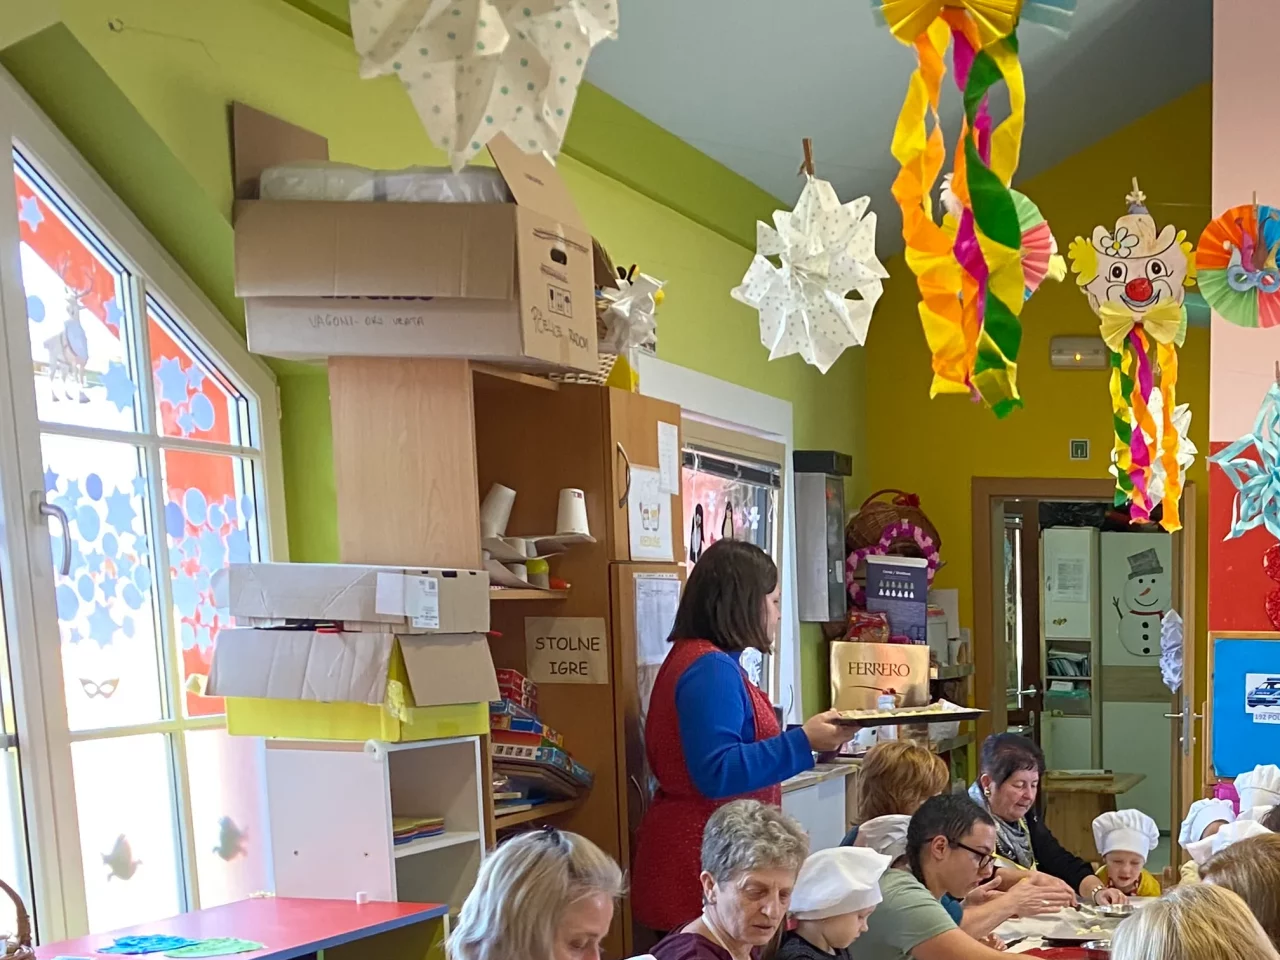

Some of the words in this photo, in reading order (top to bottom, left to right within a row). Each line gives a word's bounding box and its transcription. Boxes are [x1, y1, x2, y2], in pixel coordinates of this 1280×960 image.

[535, 636, 600, 652] STOLNE
[549, 661, 588, 676] IGRE
[848, 661, 911, 678] FERRERO
[1254, 713, 1267, 721] 192
